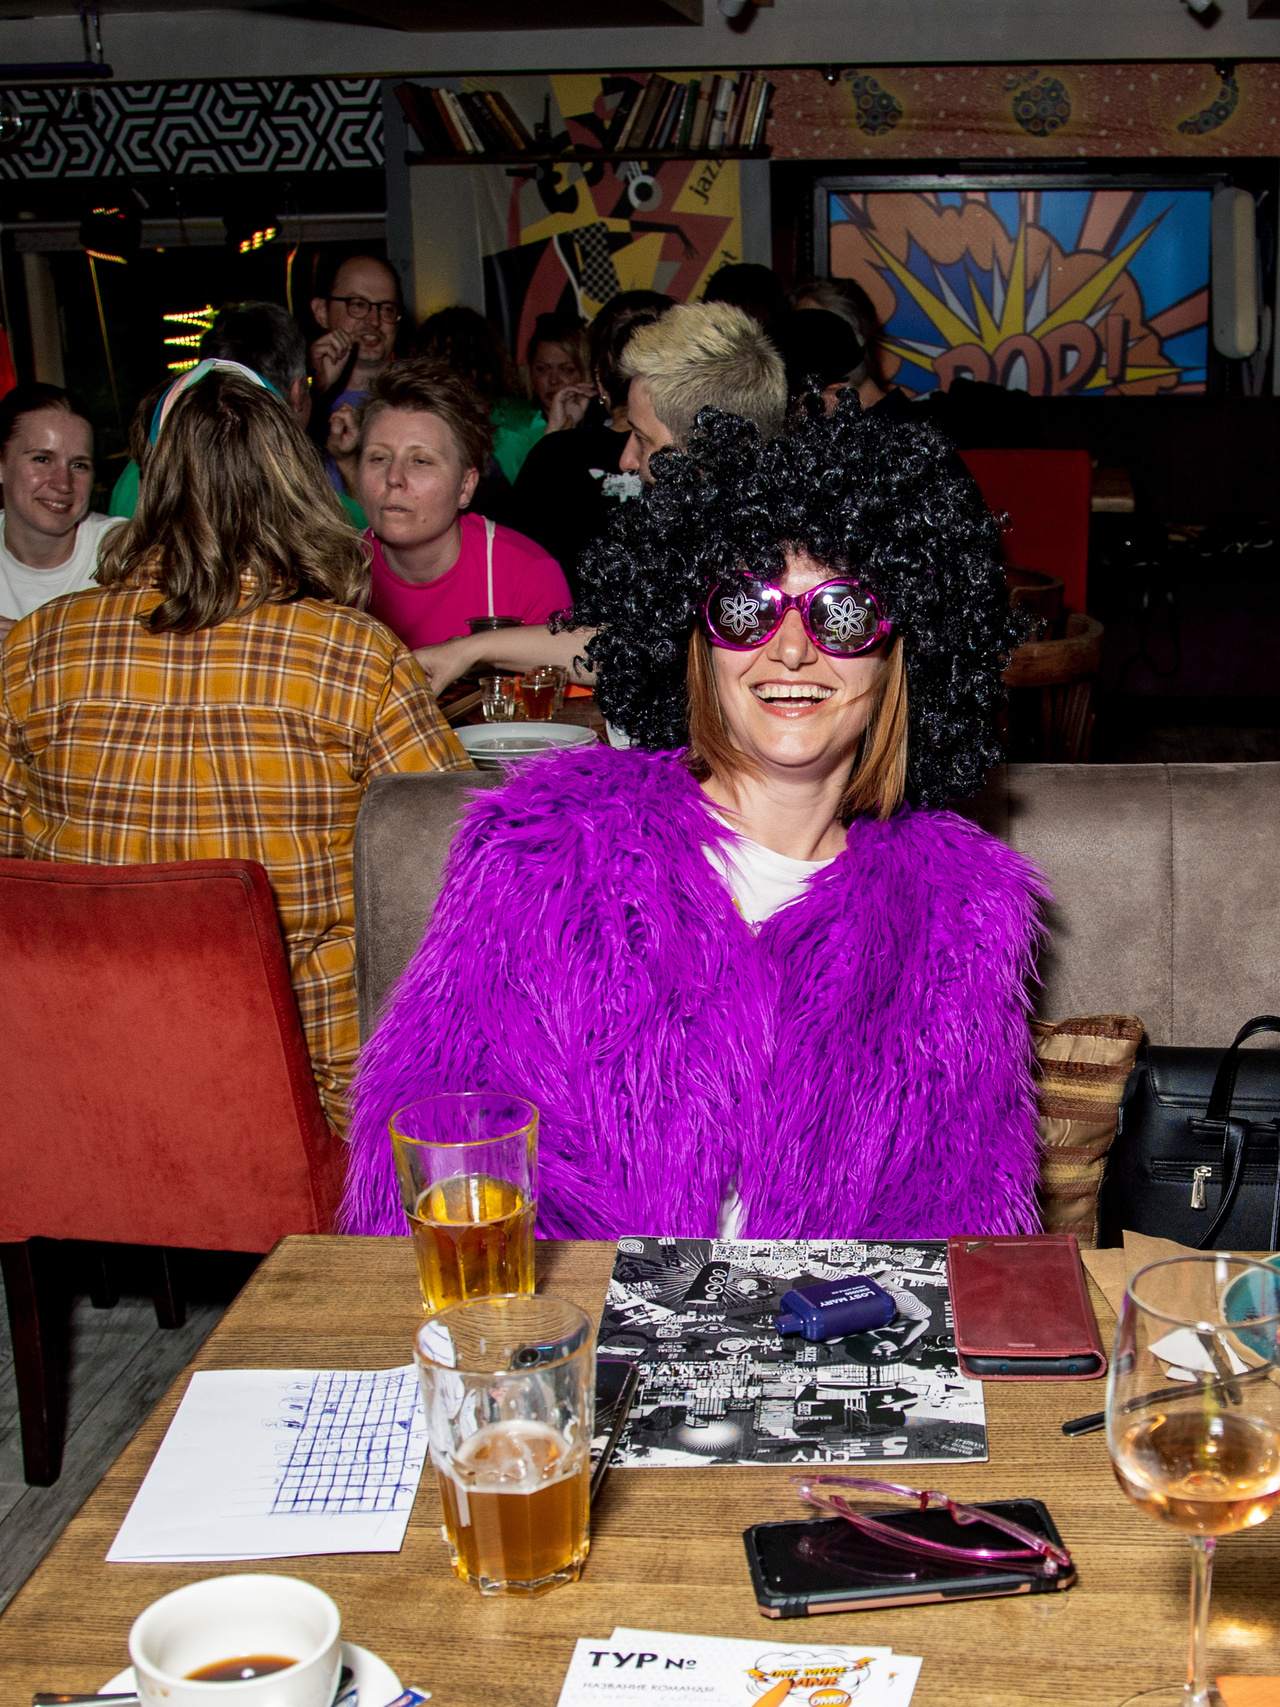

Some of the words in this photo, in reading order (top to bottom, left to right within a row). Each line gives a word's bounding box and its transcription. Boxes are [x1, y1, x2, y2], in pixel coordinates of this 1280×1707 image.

[932, 313, 1128, 397] POP!
[819, 1296, 849, 1308] MARY
[848, 1290, 876, 1301] LOST
[881, 1436, 909, 1455] 5
[790, 1450, 850, 1463] CITY
[589, 1651, 658, 1669] ТУР
[664, 1657, 697, 1670] №
[769, 1669, 799, 1678] ONE
[803, 1666, 849, 1677] MORE
[582, 1681, 647, 1691] НАЗВАНИЕ
[790, 1676, 842, 1689] AME
[810, 1694, 850, 1707] OMG!
